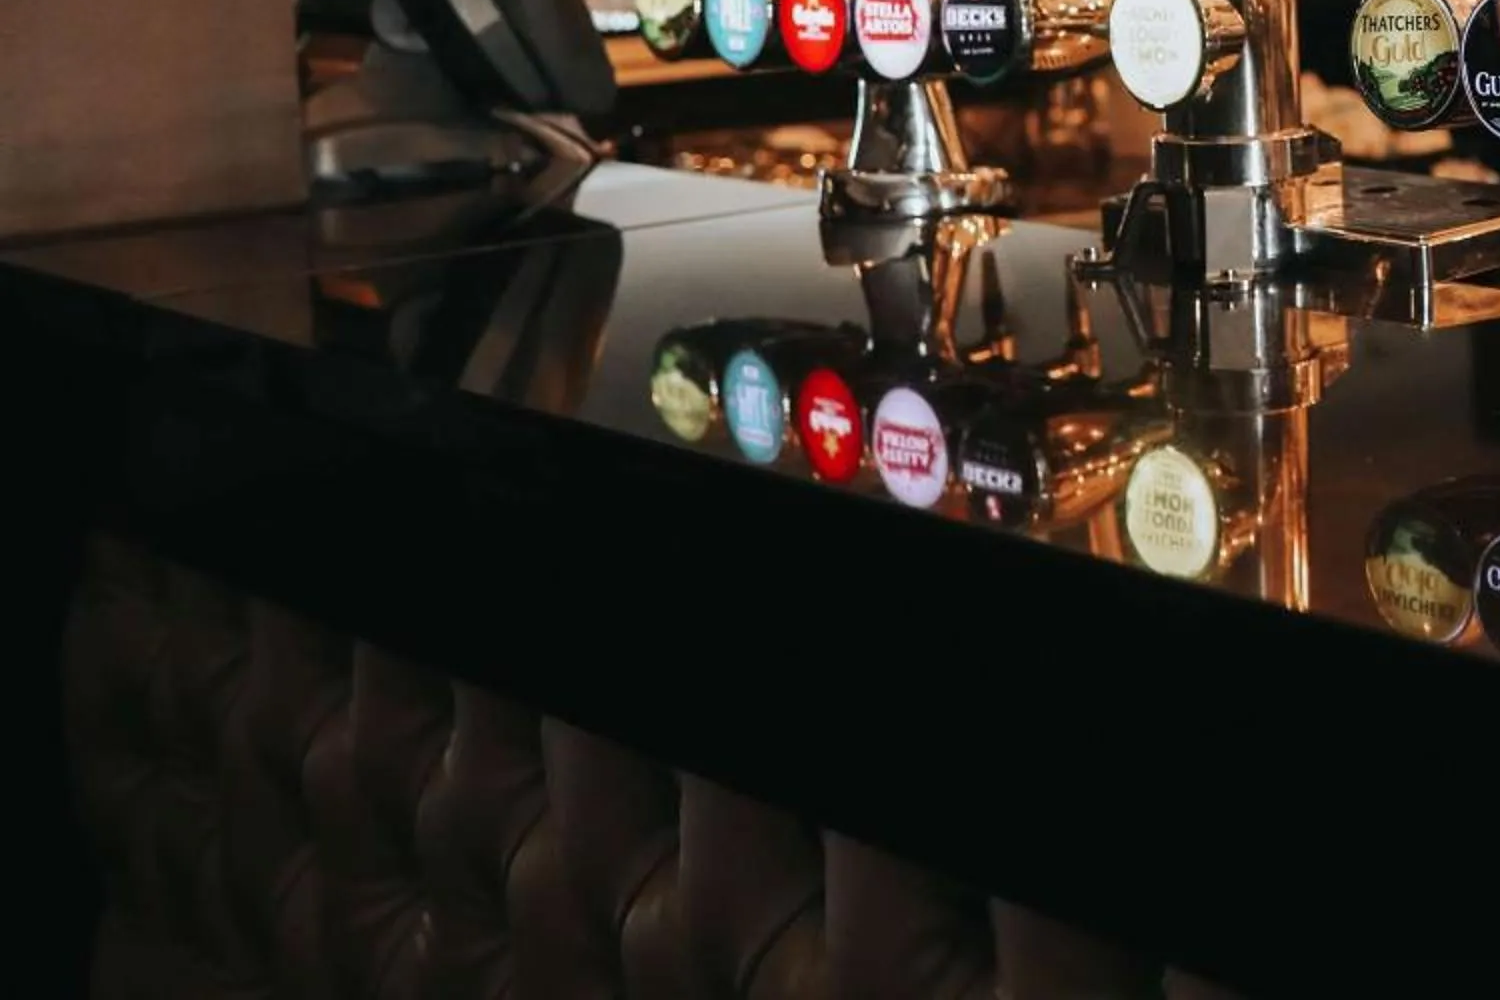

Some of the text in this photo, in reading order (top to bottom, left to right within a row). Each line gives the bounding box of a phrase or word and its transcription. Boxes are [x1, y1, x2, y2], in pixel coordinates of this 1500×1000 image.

[864, 2, 911, 18] STELLA
[1361, 13, 1441, 32] THATCHERS
[1371, 34, 1424, 67] Gold
